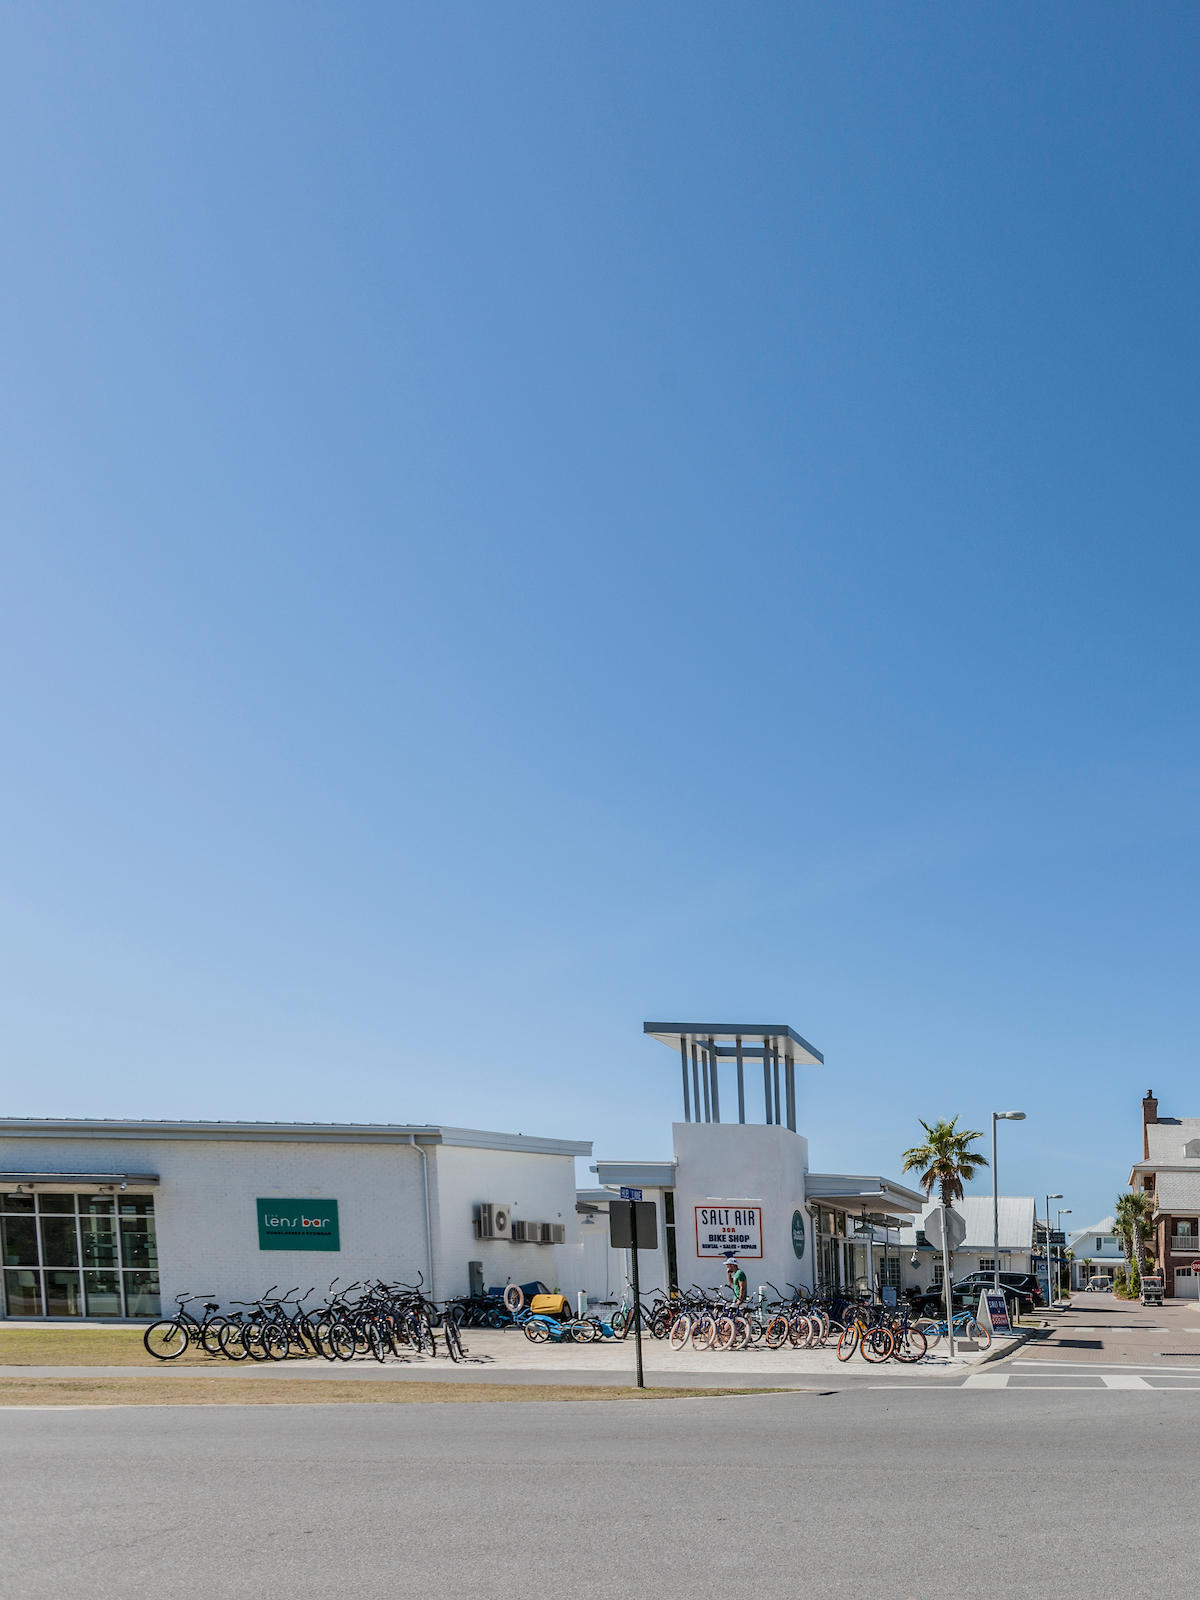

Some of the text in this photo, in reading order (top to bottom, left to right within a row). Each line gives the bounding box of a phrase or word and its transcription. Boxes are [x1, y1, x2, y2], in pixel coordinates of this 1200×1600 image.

[264, 1214, 331, 1228] lens bar
[701, 1209, 755, 1225] SALT AIR
[708, 1234, 750, 1242] BIKE SHOP
